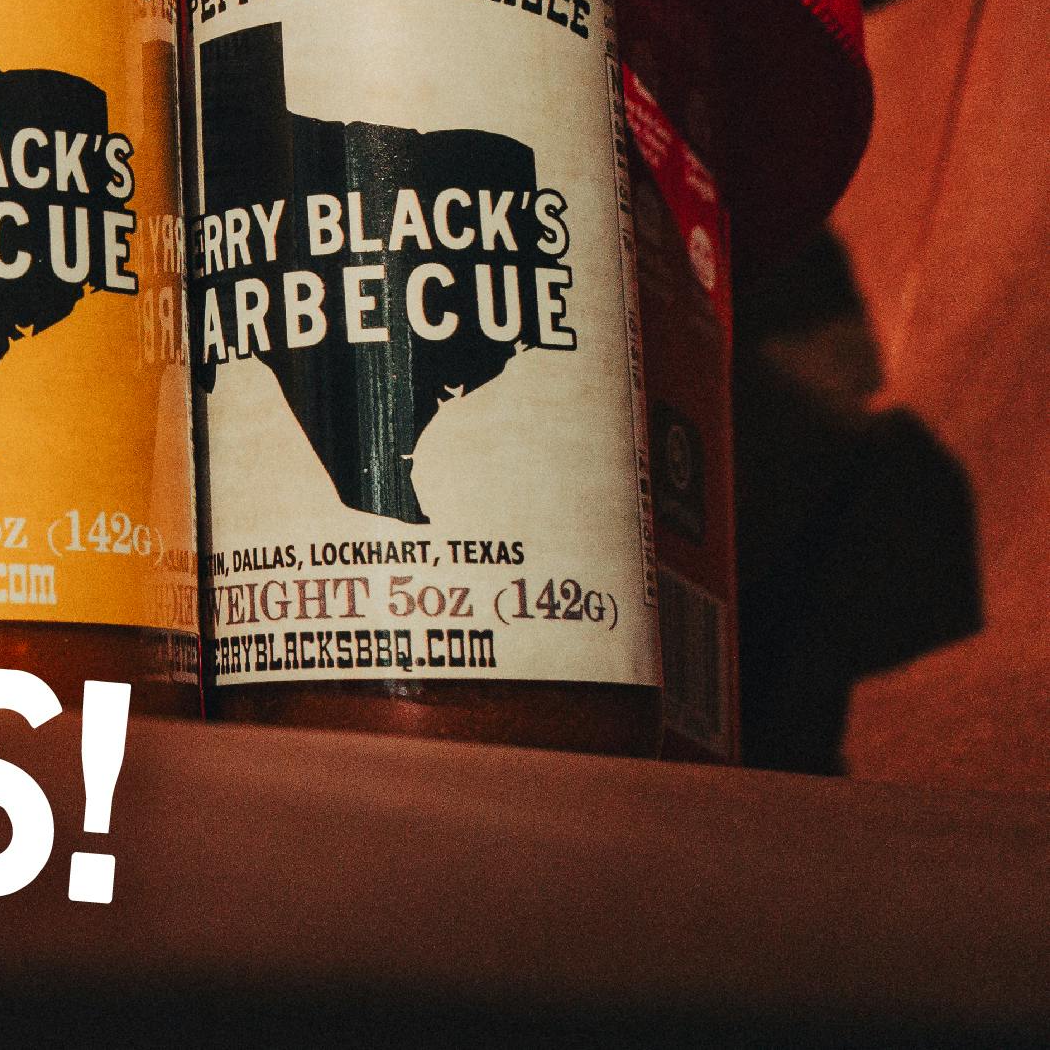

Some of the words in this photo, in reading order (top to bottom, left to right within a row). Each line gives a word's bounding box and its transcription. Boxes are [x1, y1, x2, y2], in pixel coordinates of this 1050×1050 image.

[306, 188, 569, 256] BLACK'S
[233, 544, 303, 572] DALLAS,
[311, 541, 440, 568] LOCKHART,
[448, 541, 524, 565] TEXAS
